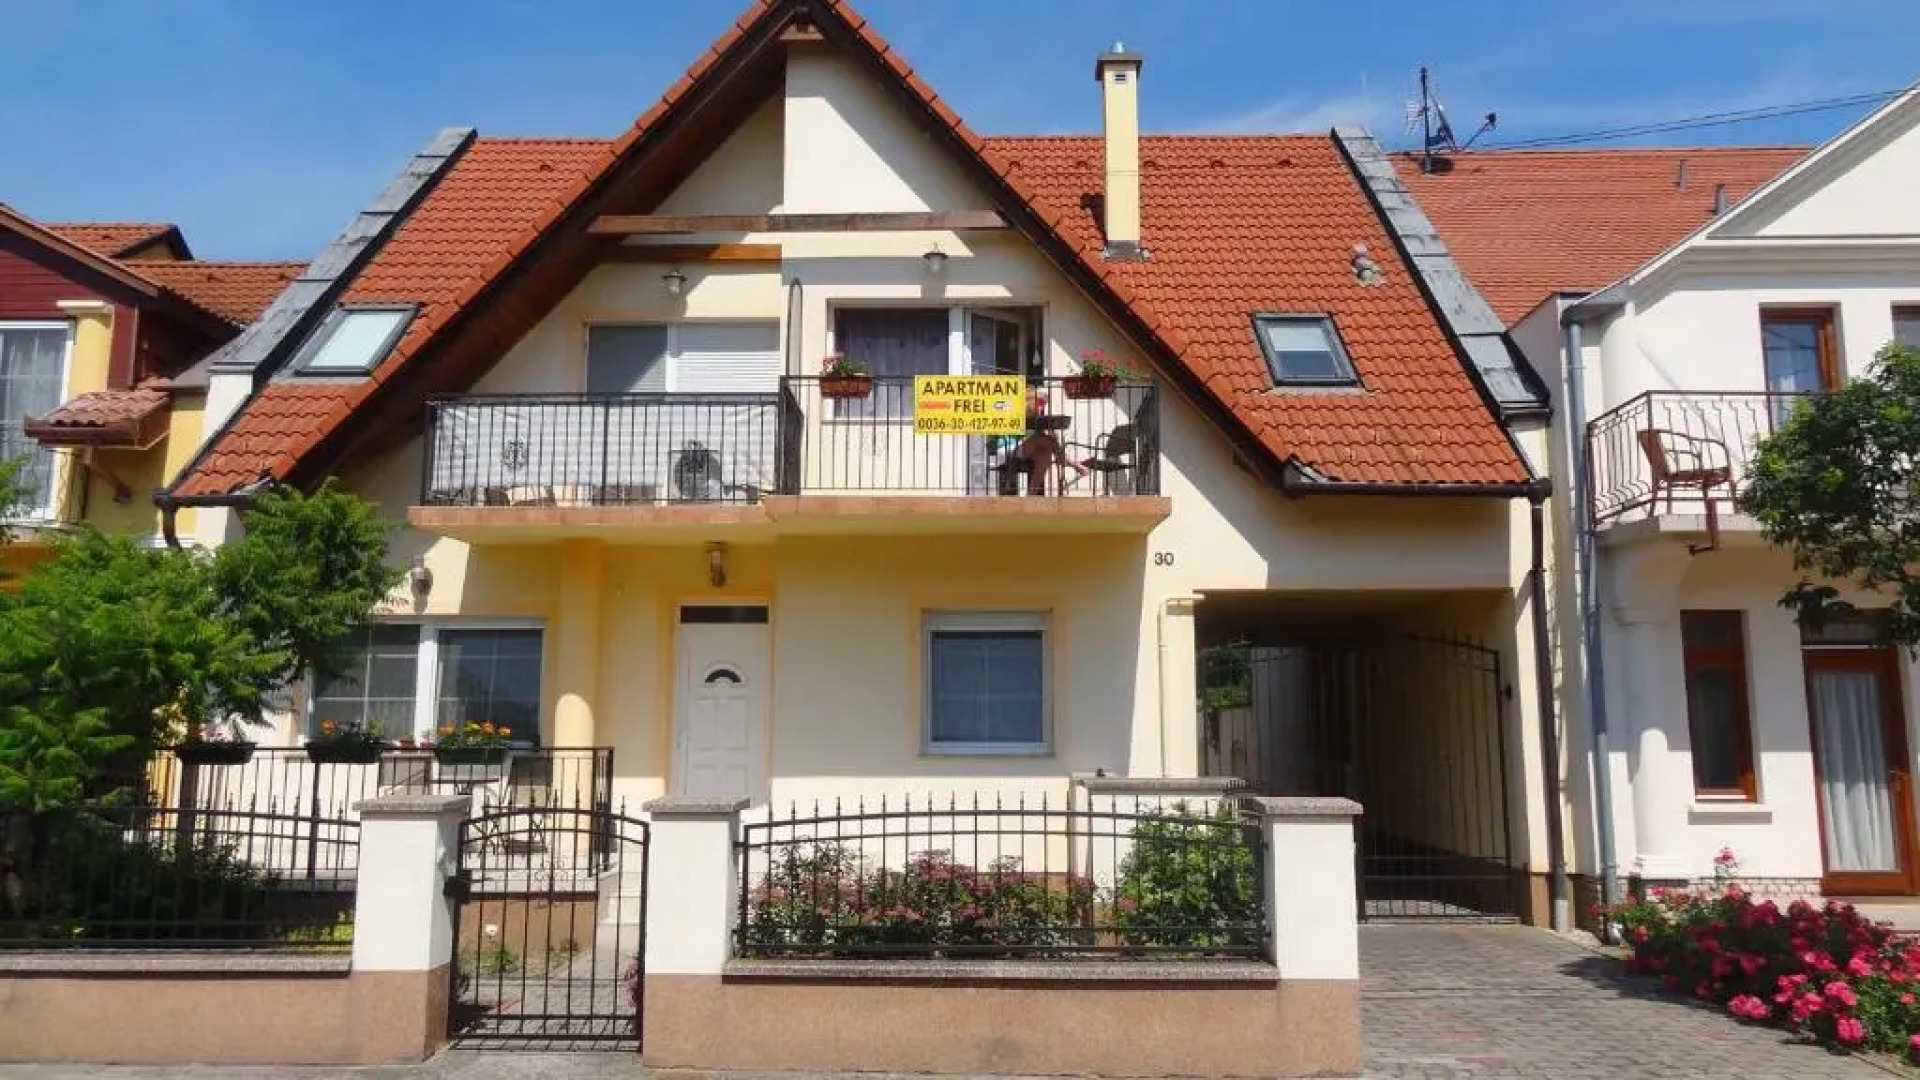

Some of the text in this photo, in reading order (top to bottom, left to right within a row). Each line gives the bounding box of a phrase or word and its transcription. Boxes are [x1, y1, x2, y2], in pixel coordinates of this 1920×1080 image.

[922, 381, 1019, 396] APARTMAN
[953, 399, 986, 413] FREI
[1154, 551, 1175, 567] 30
